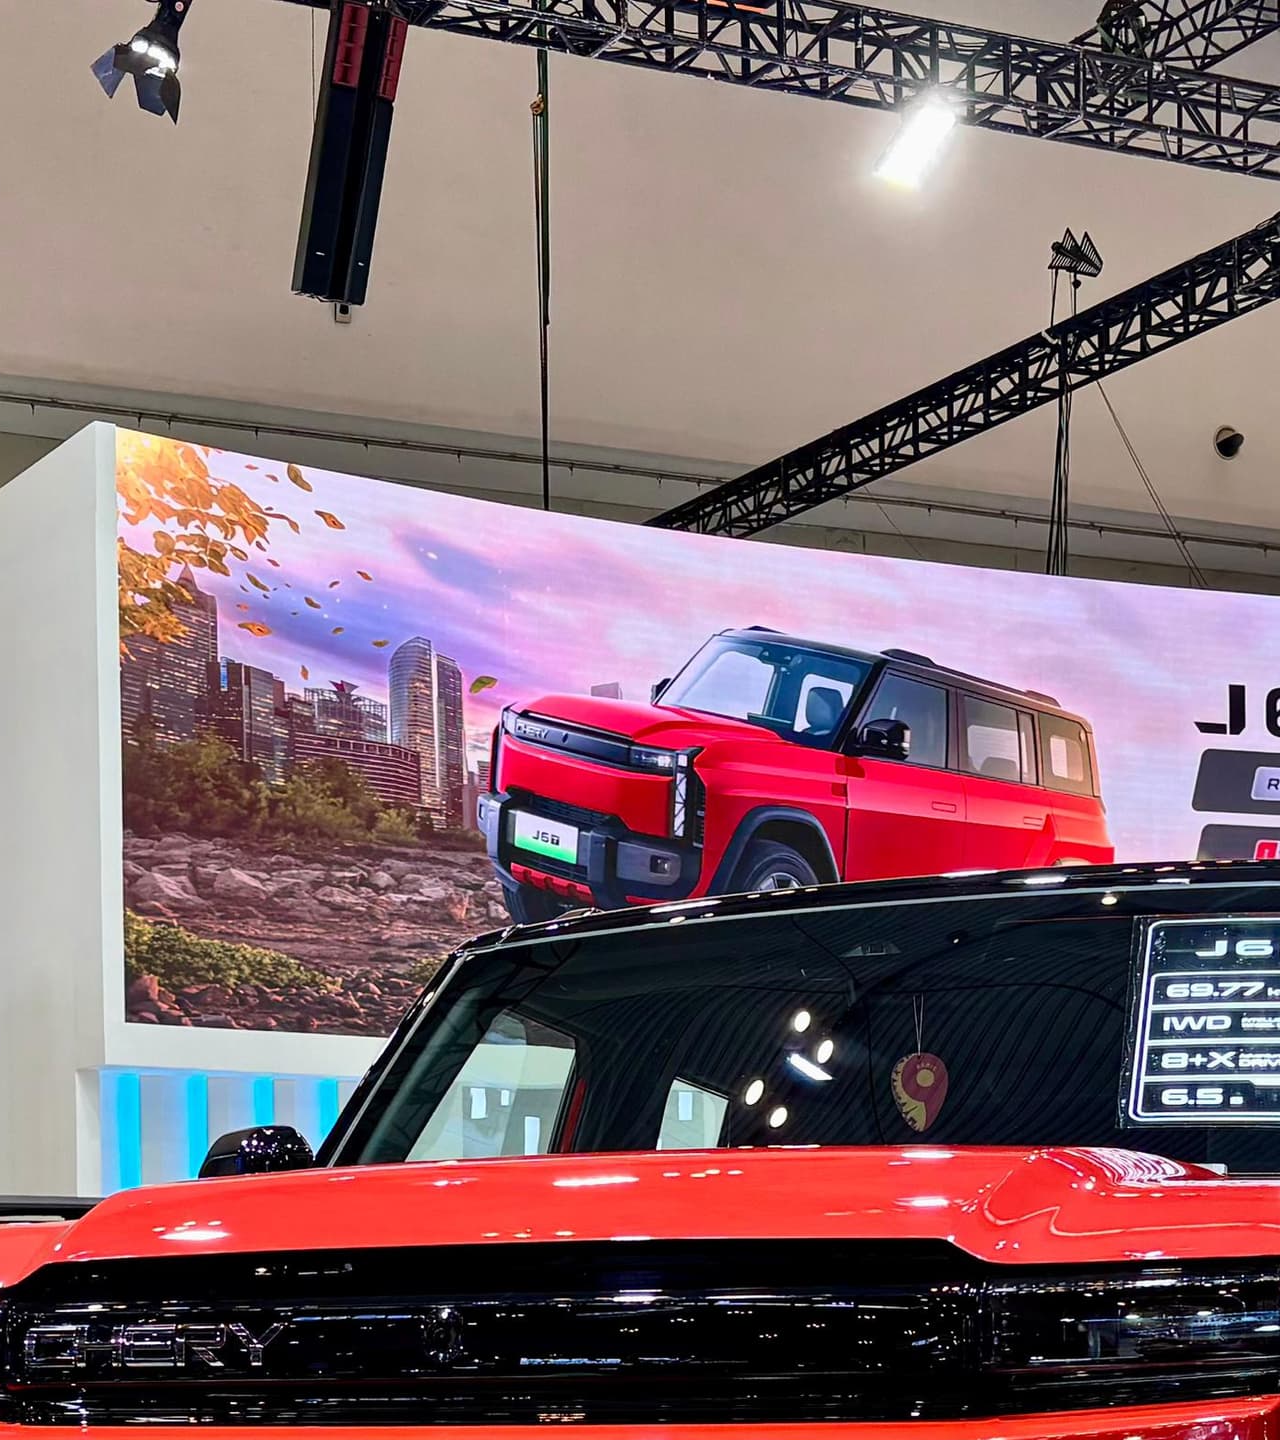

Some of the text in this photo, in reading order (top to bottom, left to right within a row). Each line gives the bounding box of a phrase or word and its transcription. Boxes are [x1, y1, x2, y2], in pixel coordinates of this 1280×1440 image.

[1166, 982, 1265, 998] 69.77
[1163, 1015, 1232, 1031] IWD
[1161, 1051, 1237, 1068] 8+X
[1161, 1088, 1224, 1105] 6.5
[24, 1323, 288, 1367] CHERY
